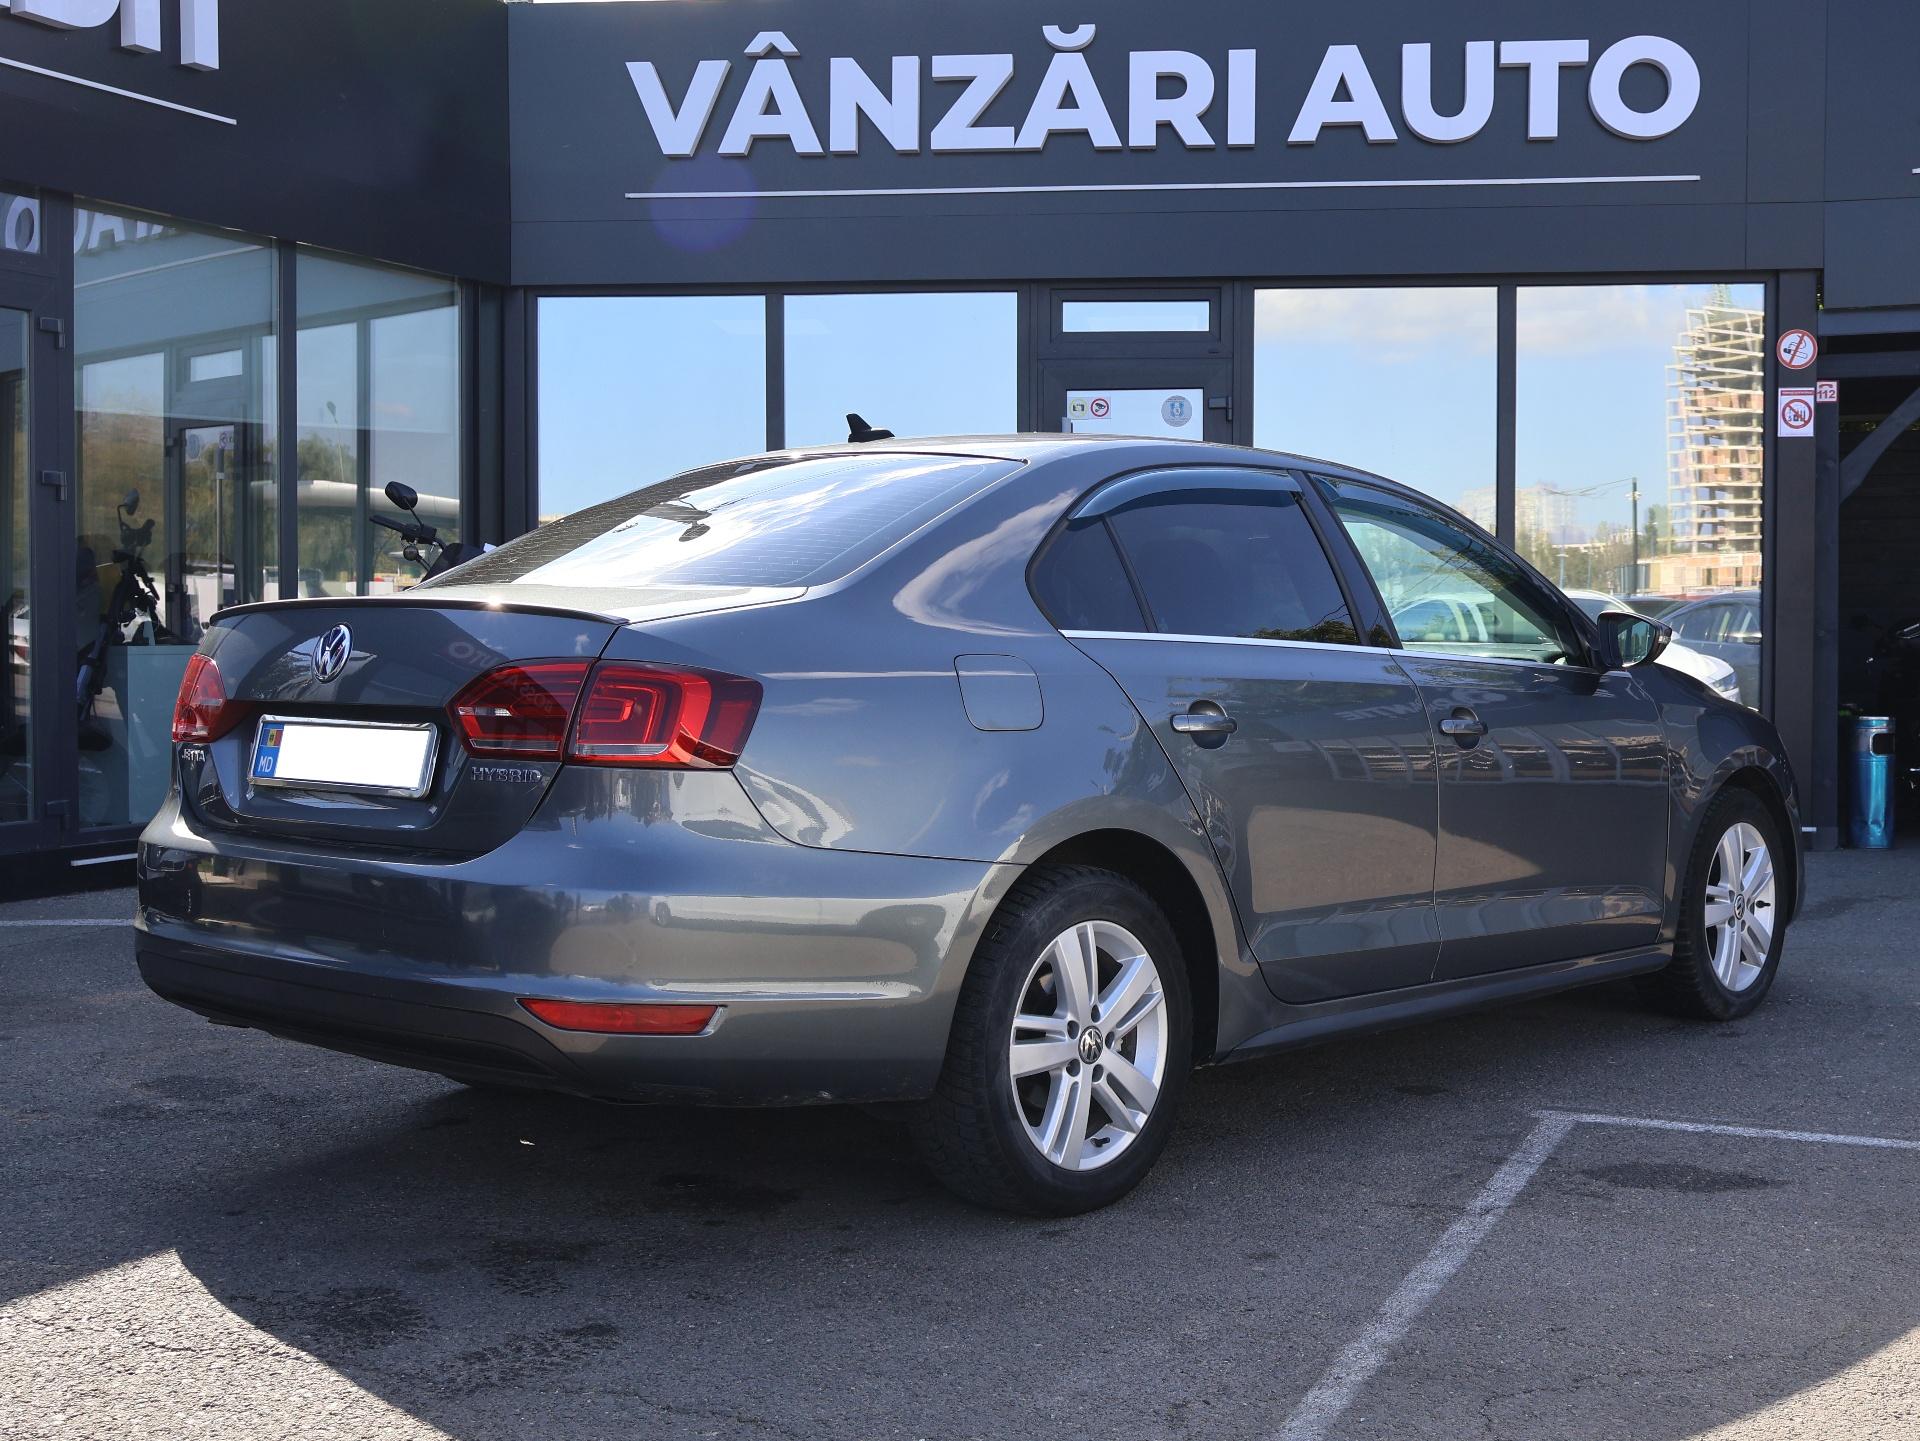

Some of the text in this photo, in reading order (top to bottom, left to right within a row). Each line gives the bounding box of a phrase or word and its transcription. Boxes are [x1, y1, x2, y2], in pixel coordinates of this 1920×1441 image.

[625, 23, 1701, 157] VÂNZĂRI AUTO
[1817, 389, 1836, 399] 112
[257, 755, 274, 773] MD
[471, 766, 543, 783] HYBRID
